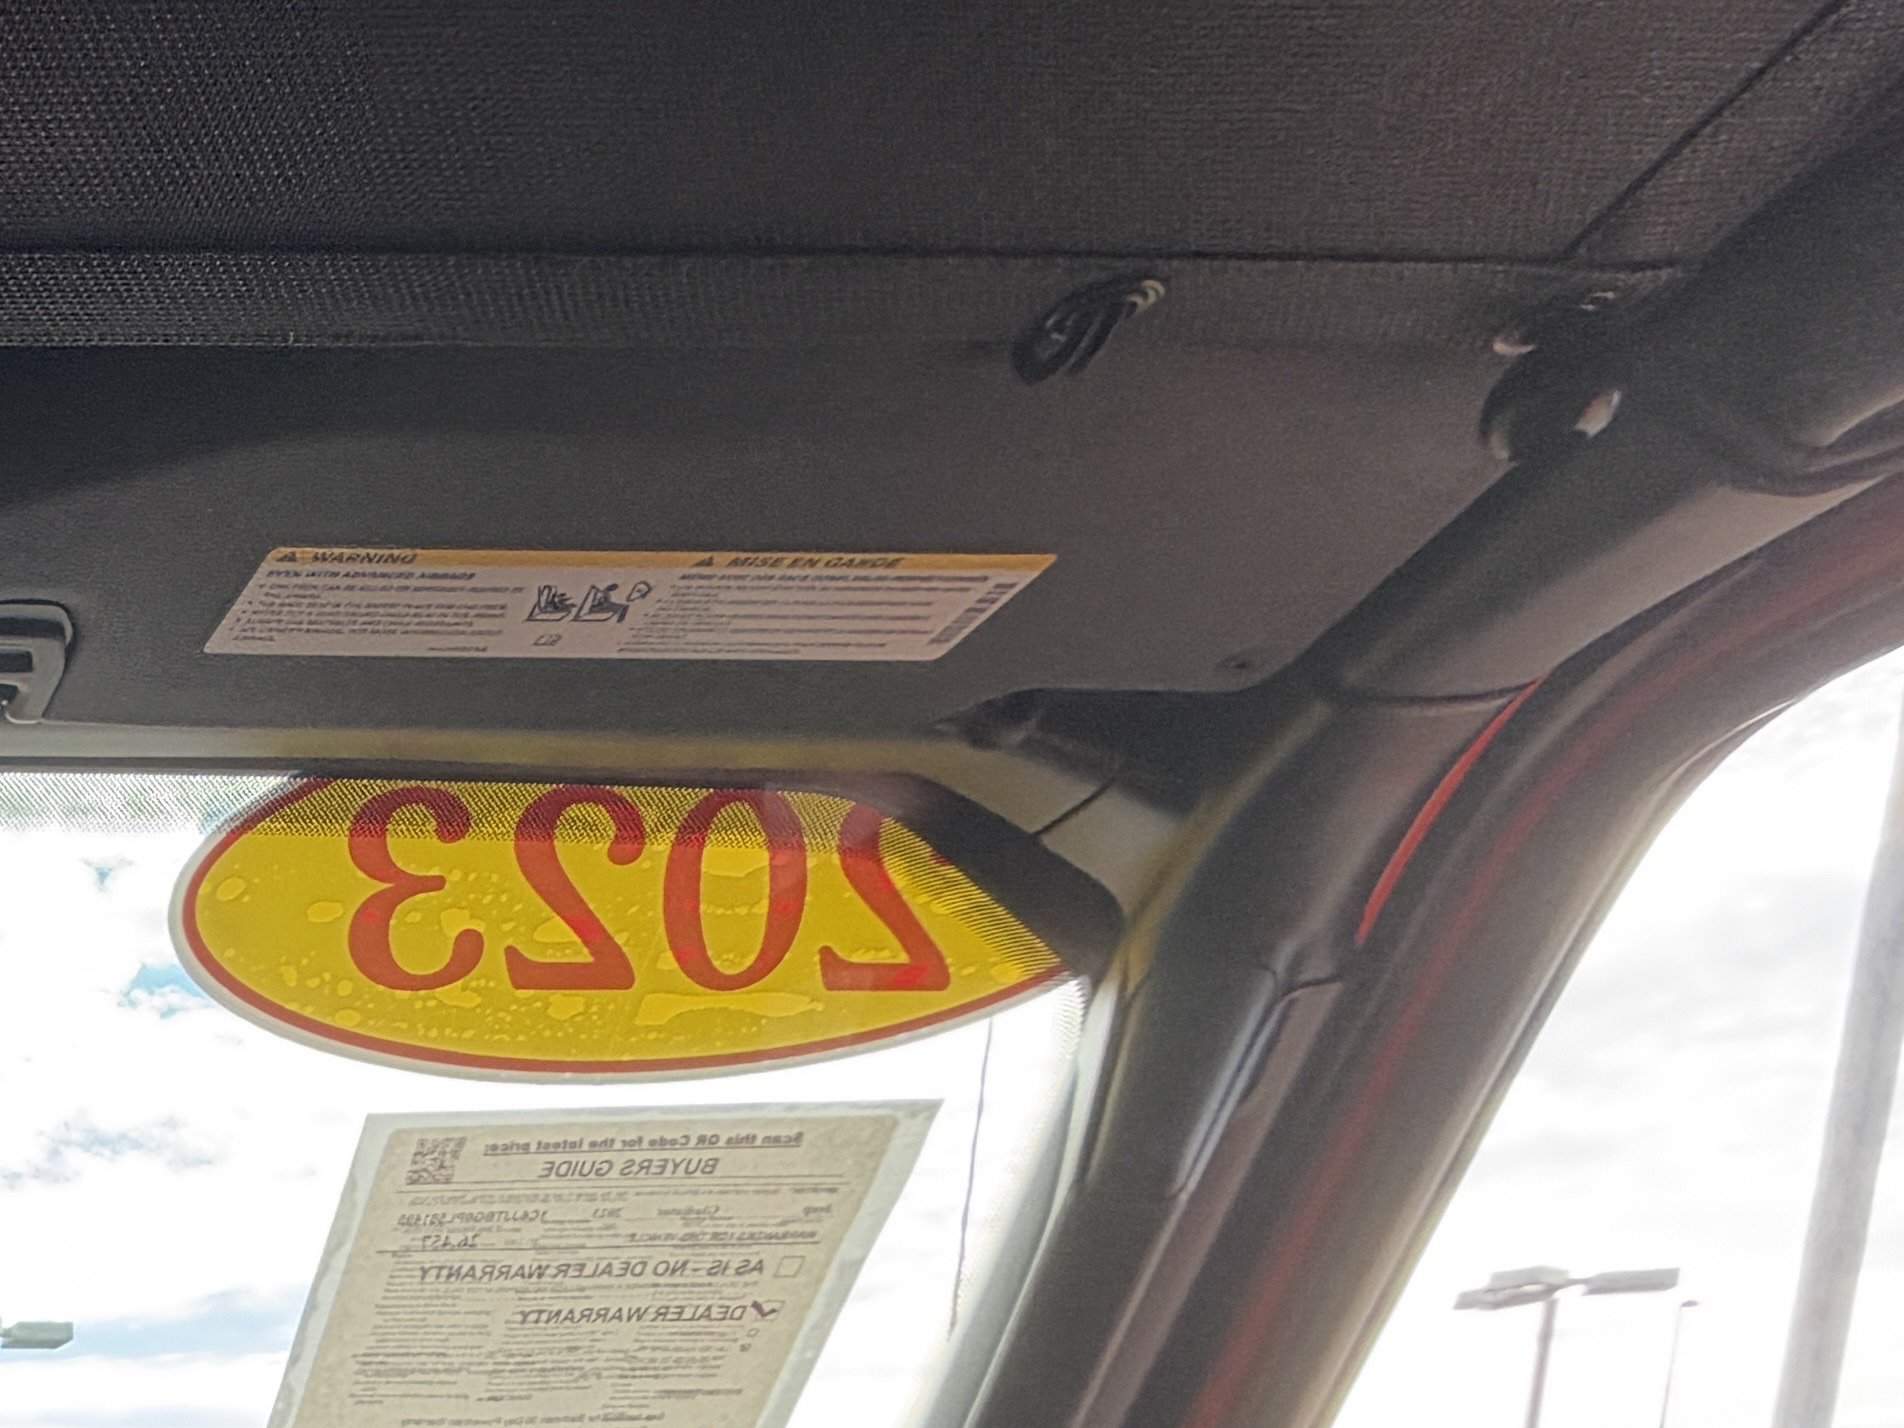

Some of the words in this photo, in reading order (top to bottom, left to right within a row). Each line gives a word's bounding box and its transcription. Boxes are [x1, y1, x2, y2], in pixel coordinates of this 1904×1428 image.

[312, 552, 418, 564] WARNING
[727, 557, 785, 568] MISE
[789, 557, 821, 568] EN
[824, 557, 905, 569] GARDE
